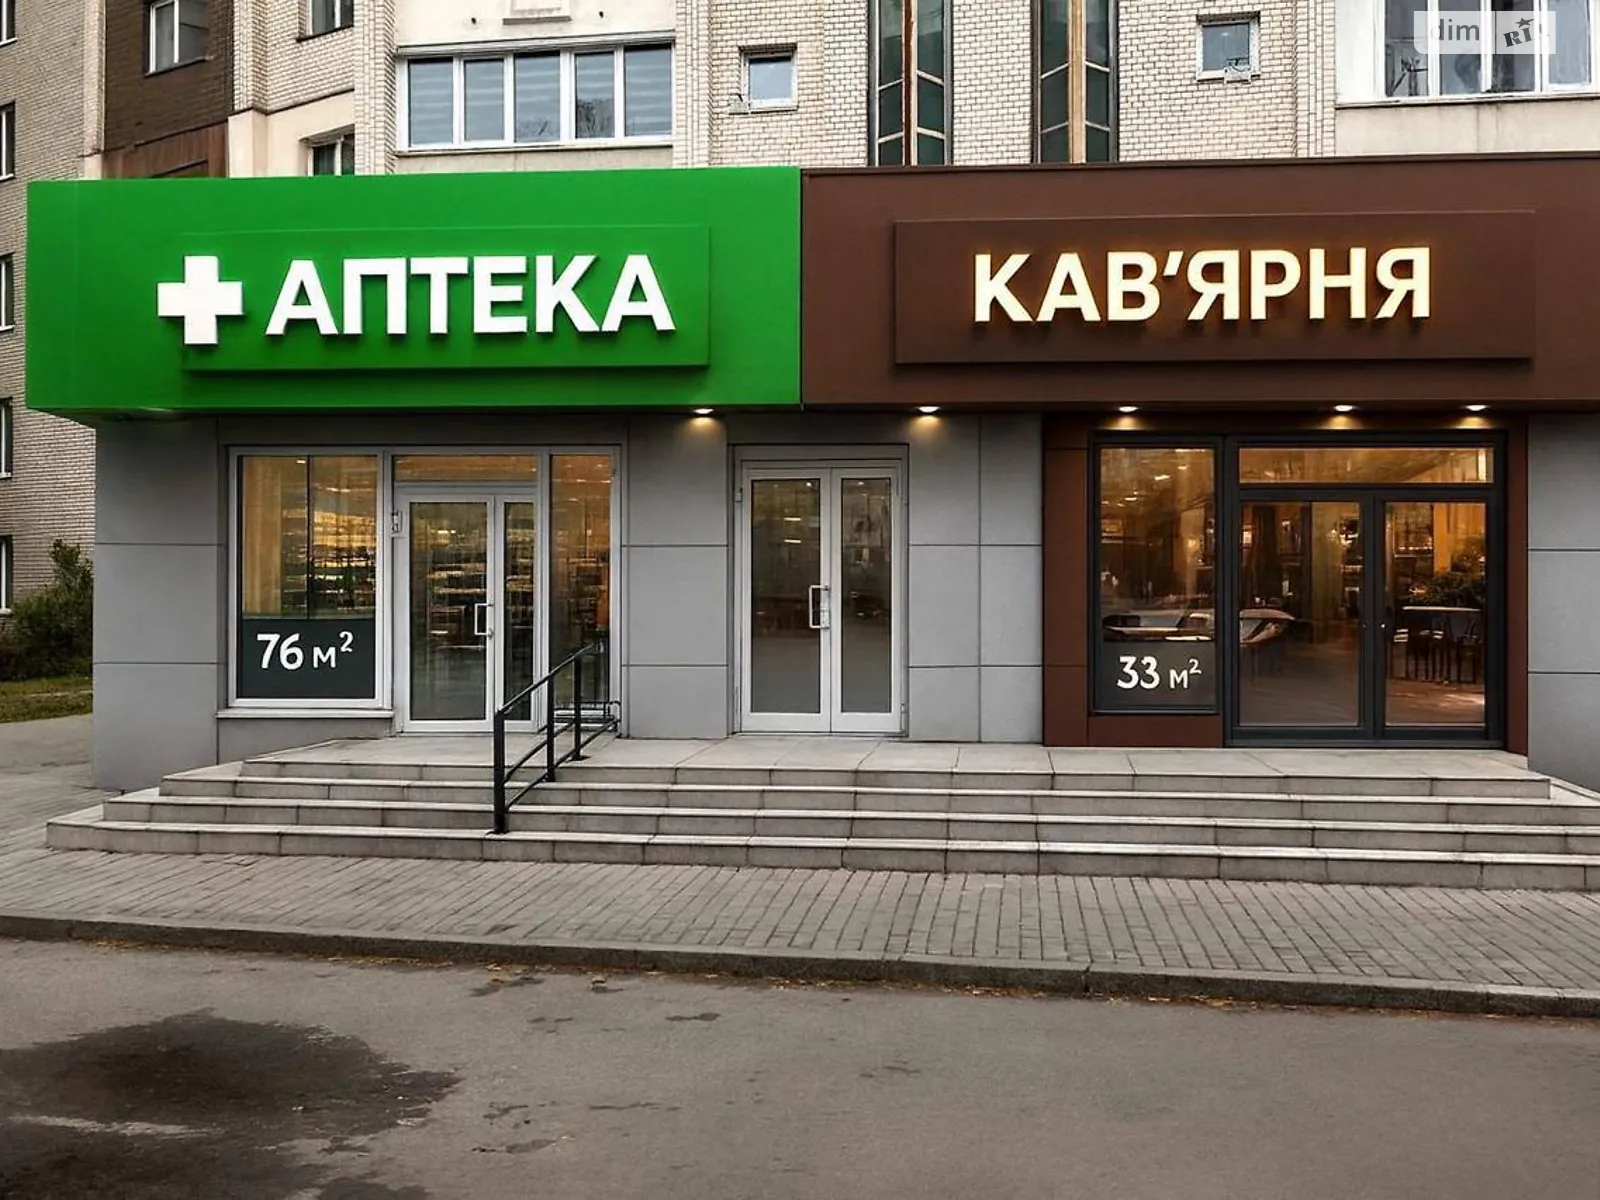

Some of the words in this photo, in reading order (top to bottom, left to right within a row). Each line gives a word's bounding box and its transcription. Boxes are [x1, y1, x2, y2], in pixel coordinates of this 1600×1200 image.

[265, 254, 677, 336] АПТЕКА
[973, 246, 1432, 323] КАВ’ЯРНЯ
[256, 632, 304, 671] 76
[1116, 655, 1161, 690] 33
